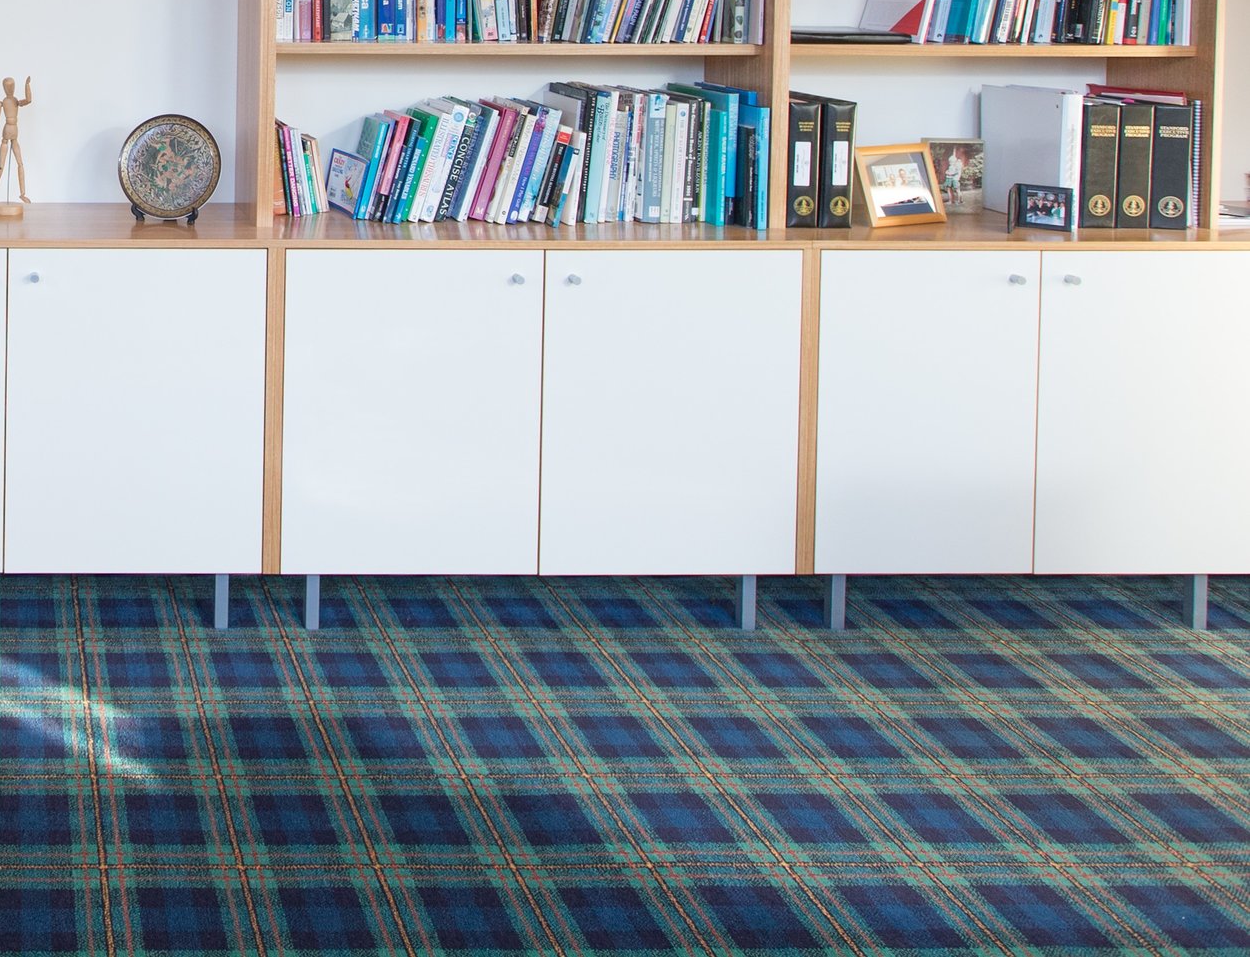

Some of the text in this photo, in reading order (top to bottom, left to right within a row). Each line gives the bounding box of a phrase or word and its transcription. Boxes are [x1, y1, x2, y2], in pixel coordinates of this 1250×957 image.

[628, 8, 640, 26] PALIN
[601, 111, 609, 136] Dictionary
[286, 150, 298, 207] BETTER DANCING
[399, 147, 422, 200] BERNARD VENABLES
[417, 116, 450, 198] ILLUSTRATED THESAURUS
[438, 135, 471, 216] CONCISE ATLAS
[549, 162, 558, 182] SURVIVAL
[609, 131, 620, 181] PHOTOGRAPHY
[542, 181, 553, 204] HANDBOOK
